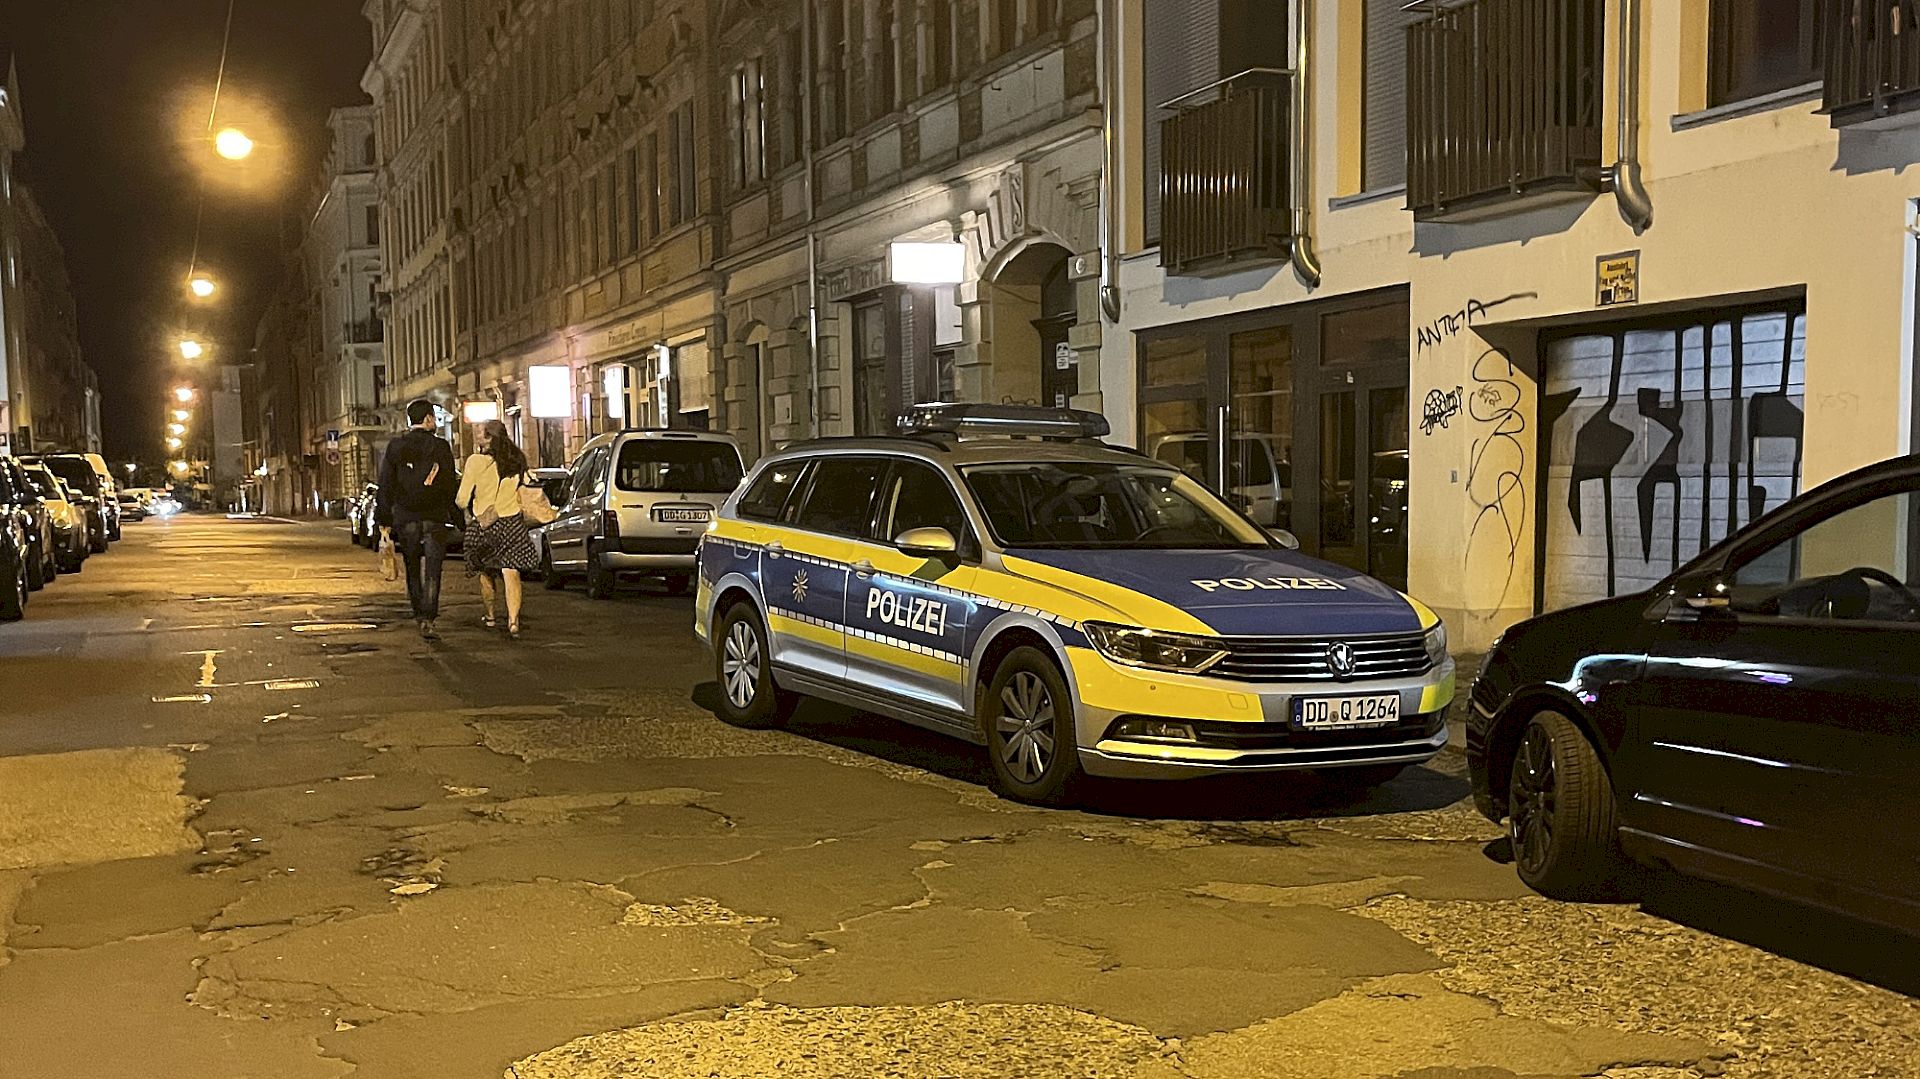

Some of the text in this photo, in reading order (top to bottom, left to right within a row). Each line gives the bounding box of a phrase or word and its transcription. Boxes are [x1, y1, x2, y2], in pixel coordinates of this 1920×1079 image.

[1190, 576, 1347, 592] POLIZEI
[866, 587, 948, 637] POLIZEI
[1305, 701, 1328, 723] DD
[1341, 700, 1351, 721] Q
[1356, 698, 1397, 721] 1264
